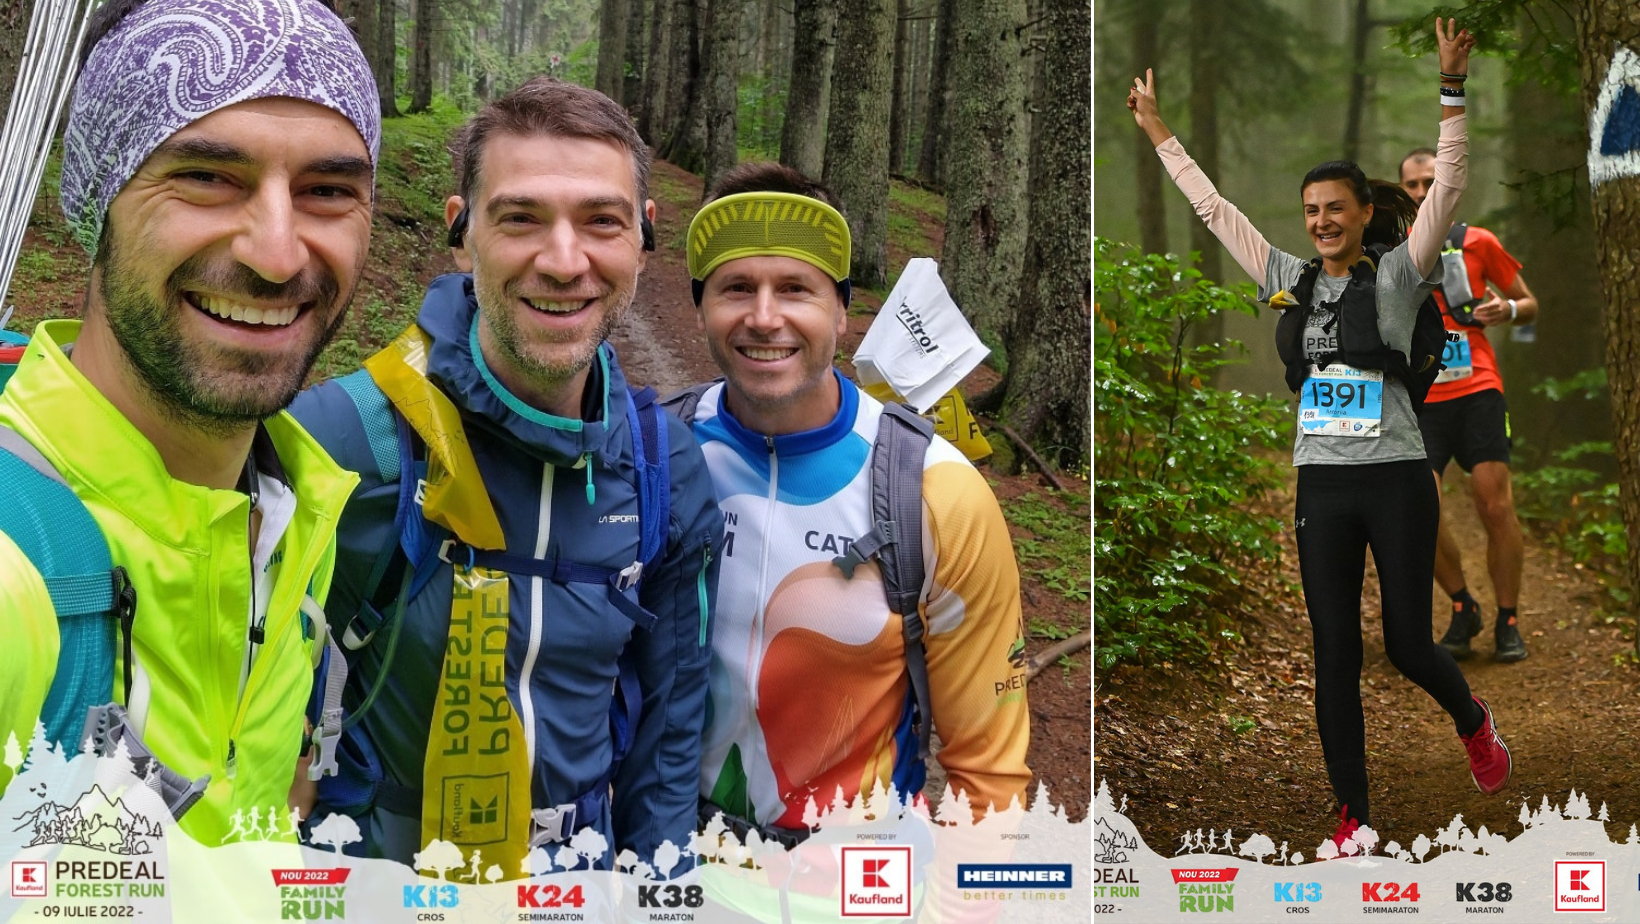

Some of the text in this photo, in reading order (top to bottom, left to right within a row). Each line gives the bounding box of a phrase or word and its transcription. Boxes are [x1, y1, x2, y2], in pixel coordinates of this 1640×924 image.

[899, 301, 939, 354] rritrol
[1306, 337, 1338, 350] PRE
[1442, 344, 1462, 361] 01
[1312, 381, 1366, 409] 1391
[724, 511, 738, 526] UN
[804, 530, 855, 557] CAT
